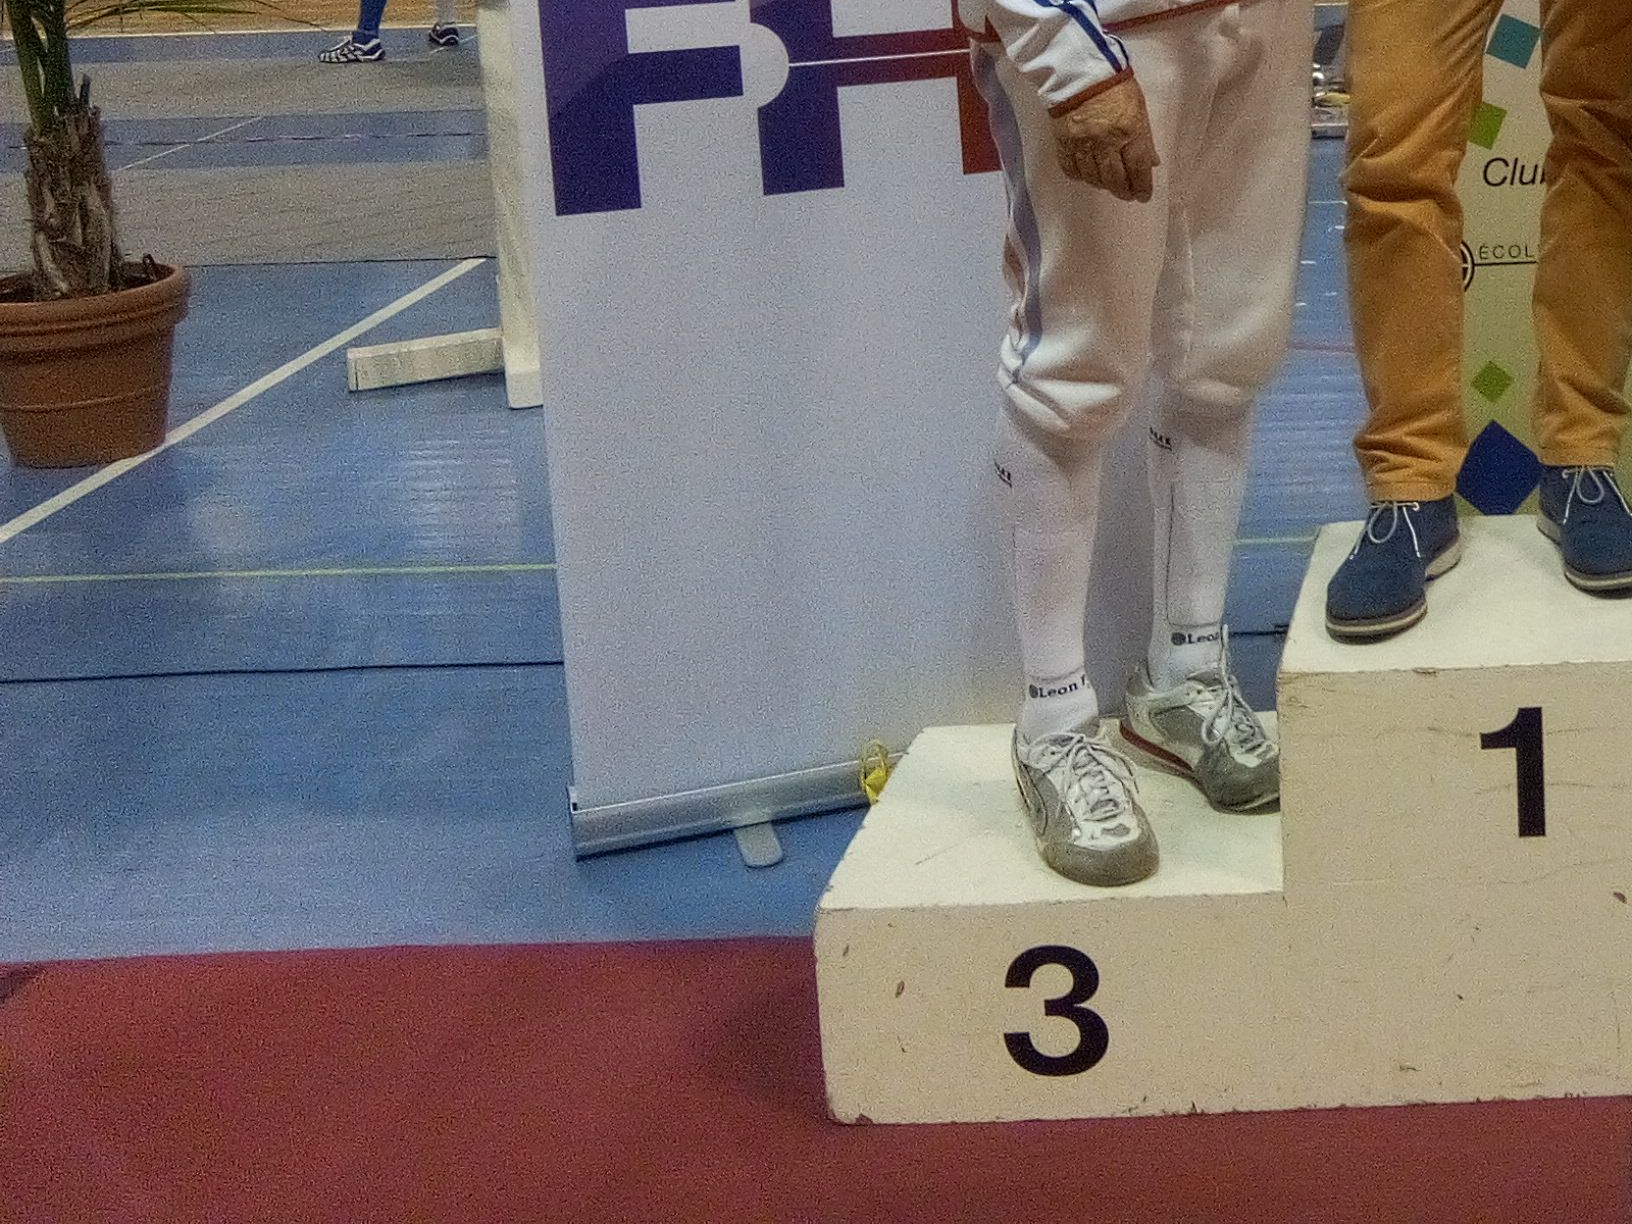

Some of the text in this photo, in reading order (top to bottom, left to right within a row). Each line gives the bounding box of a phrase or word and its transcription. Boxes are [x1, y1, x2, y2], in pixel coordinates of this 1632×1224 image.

[1483, 156, 1546, 187] Clu
[1479, 243, 1535, 260] ÉCOL
[1187, 631, 1220, 645] Leo
[1038, 681, 1079, 699] Leon
[1480, 706, 1547, 837] 1
[1003, 945, 1111, 1076] 3
